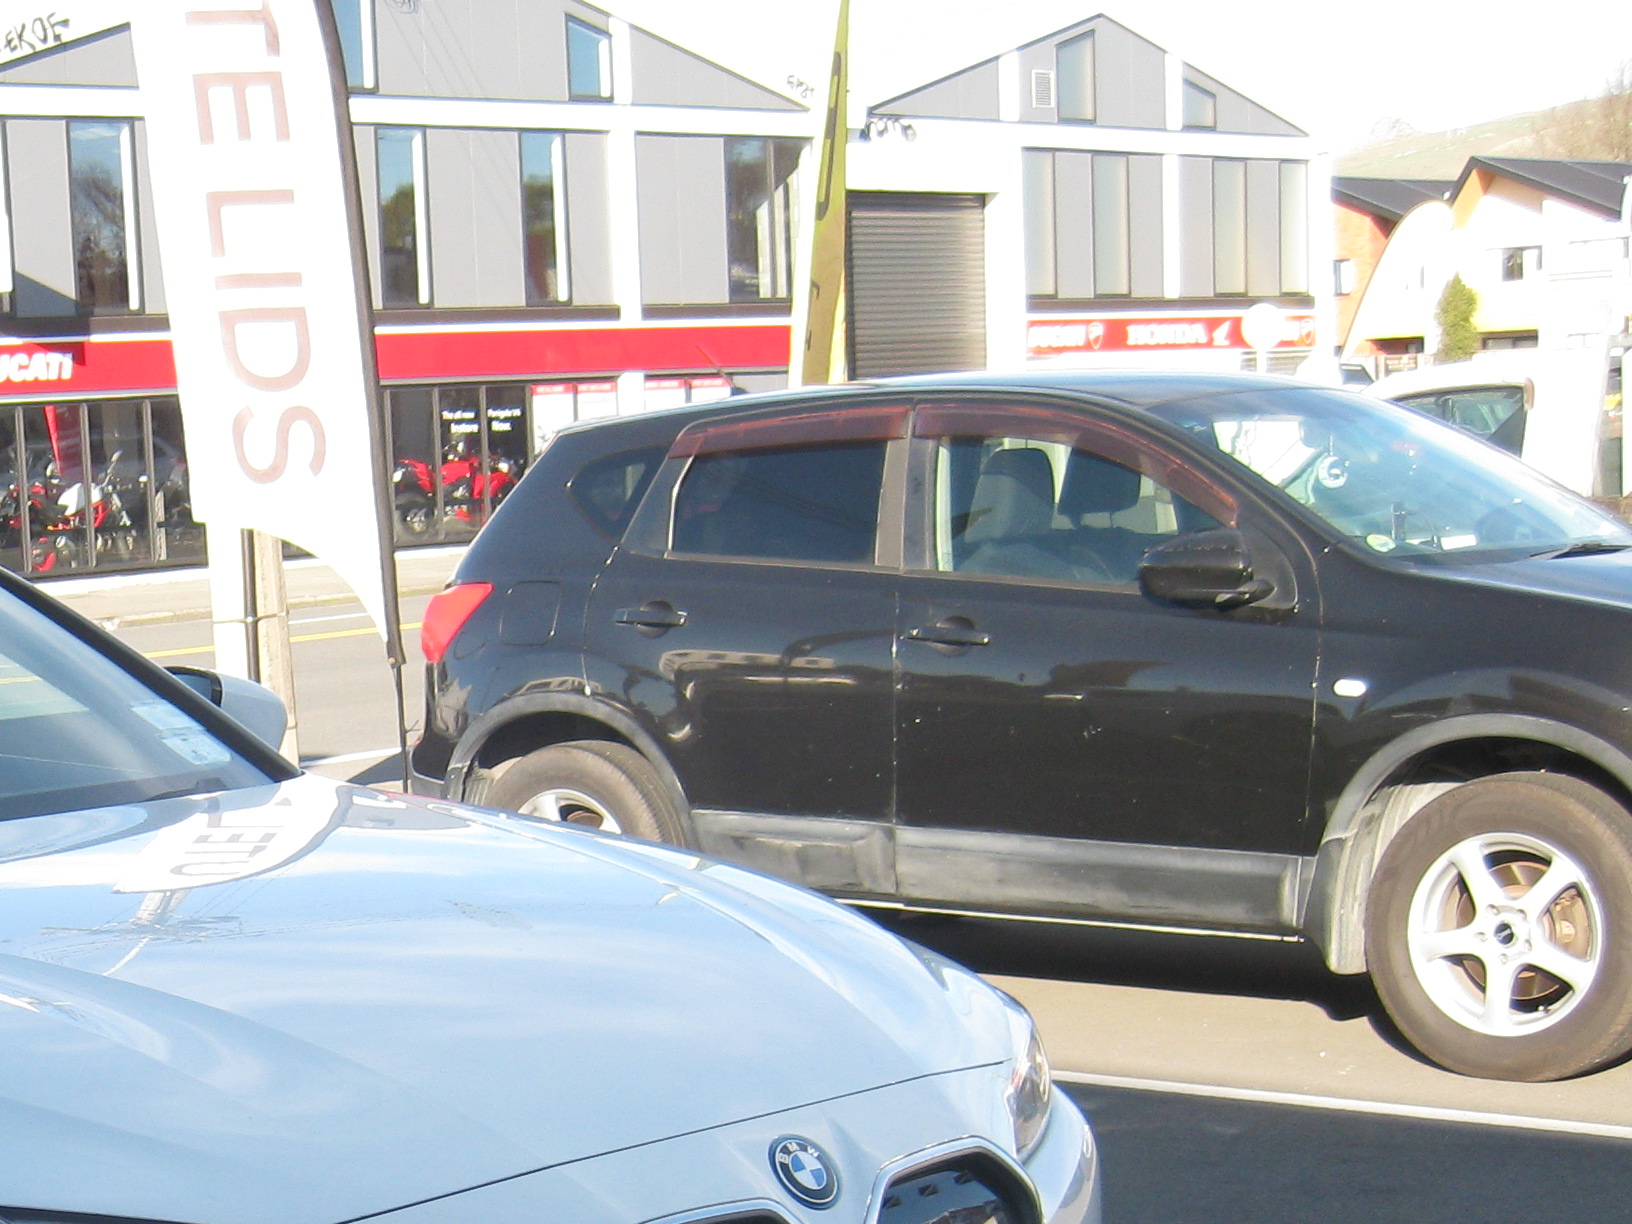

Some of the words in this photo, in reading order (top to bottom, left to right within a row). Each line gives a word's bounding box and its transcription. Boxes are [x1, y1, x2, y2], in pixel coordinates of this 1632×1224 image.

[206, 189, 326, 485] LIDS
[1126, 323, 1208, 346] HONDA
[777, 1141, 821, 1165] BMW
